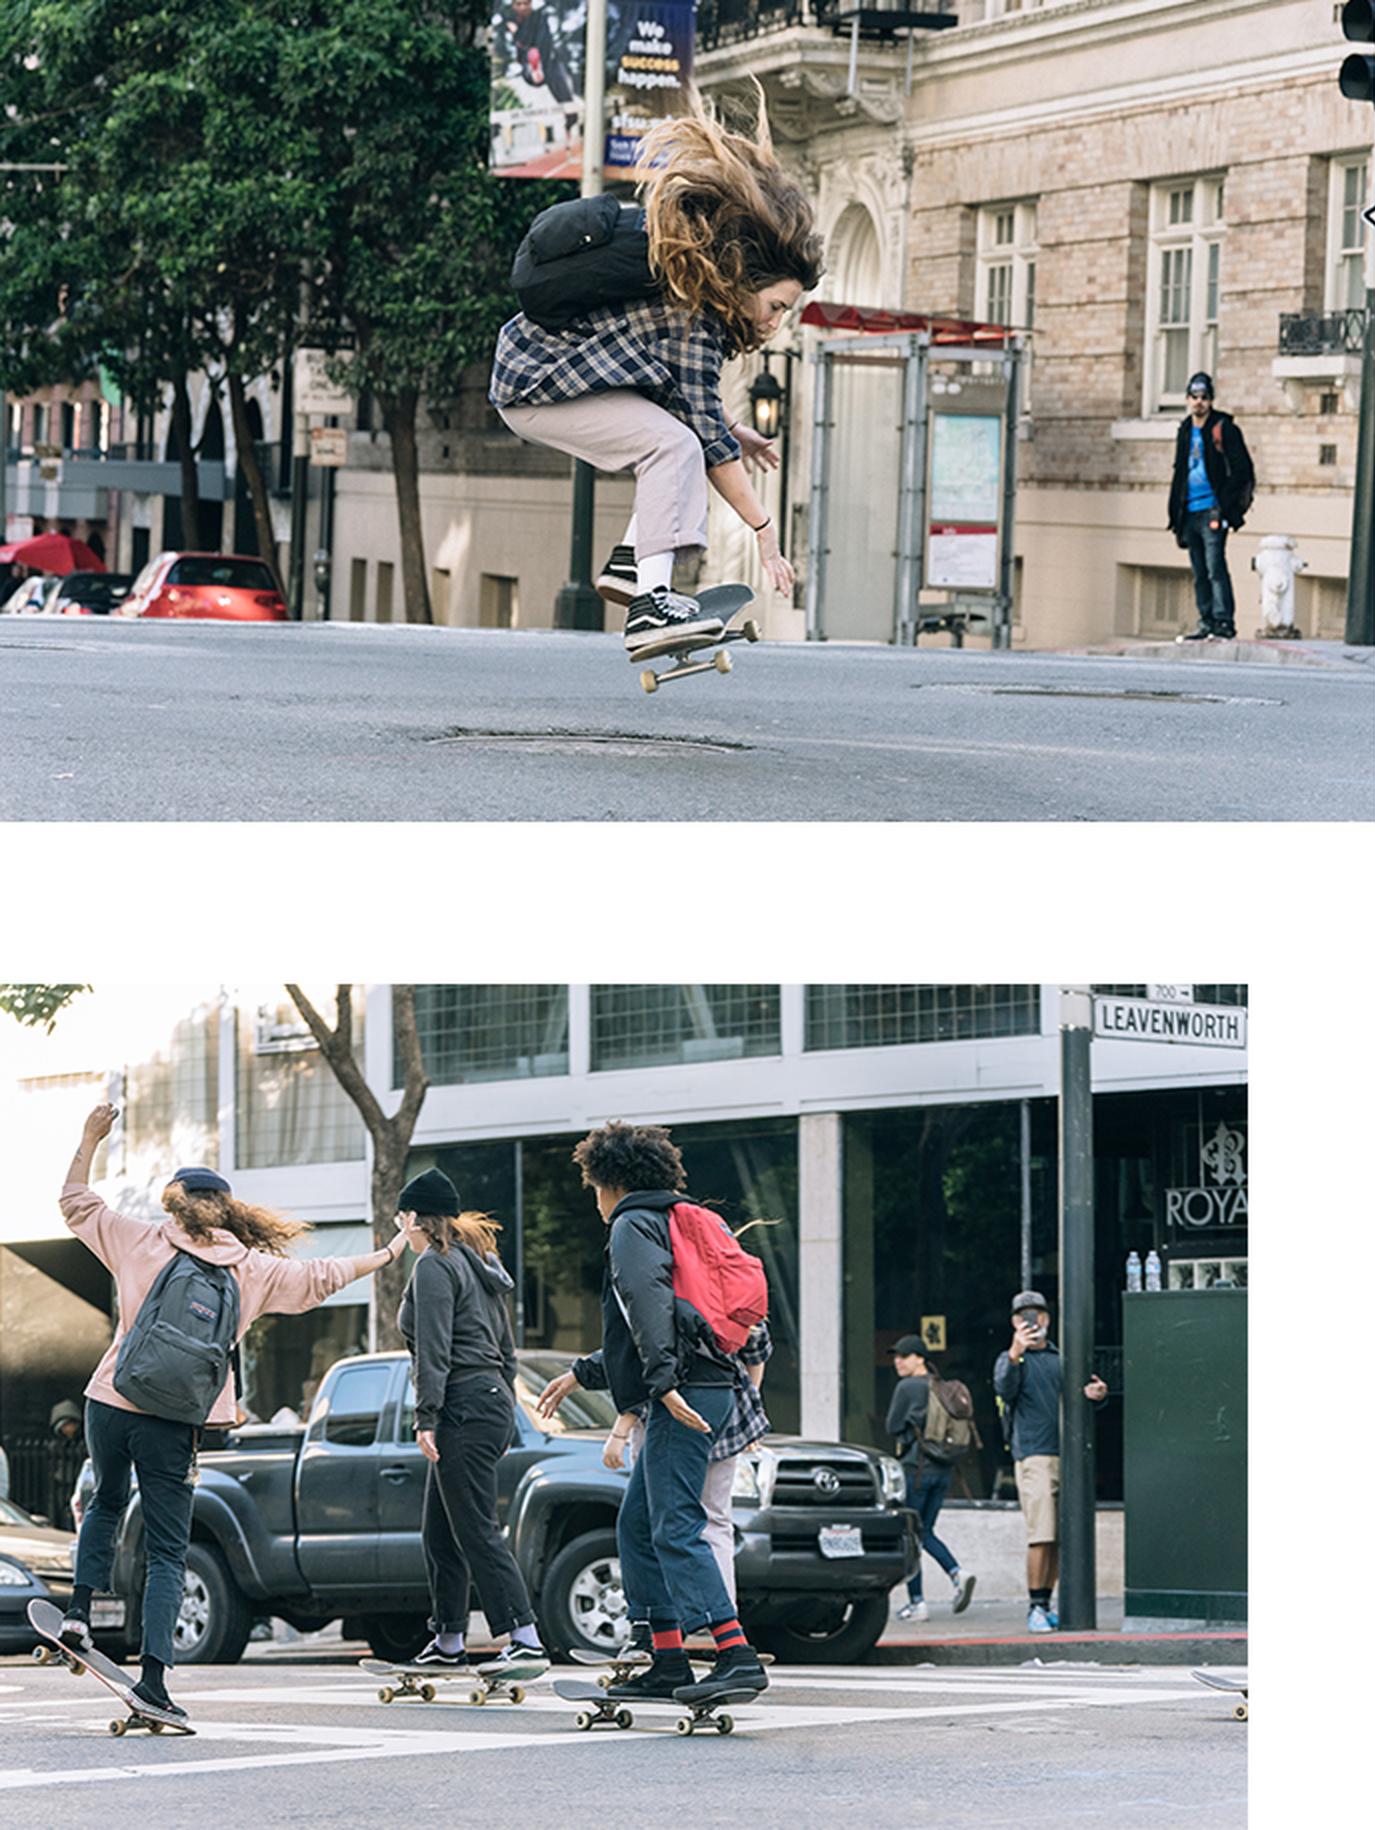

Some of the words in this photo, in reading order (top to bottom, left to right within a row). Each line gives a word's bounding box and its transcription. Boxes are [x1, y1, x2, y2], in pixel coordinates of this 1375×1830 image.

[638, 21, 665, 39] We
[629, 38, 673, 55] make
[621, 56, 680, 72] success
[618, 68, 682, 89] happen.
[1103, 1005, 1238, 1040] LEAVENWORTH
